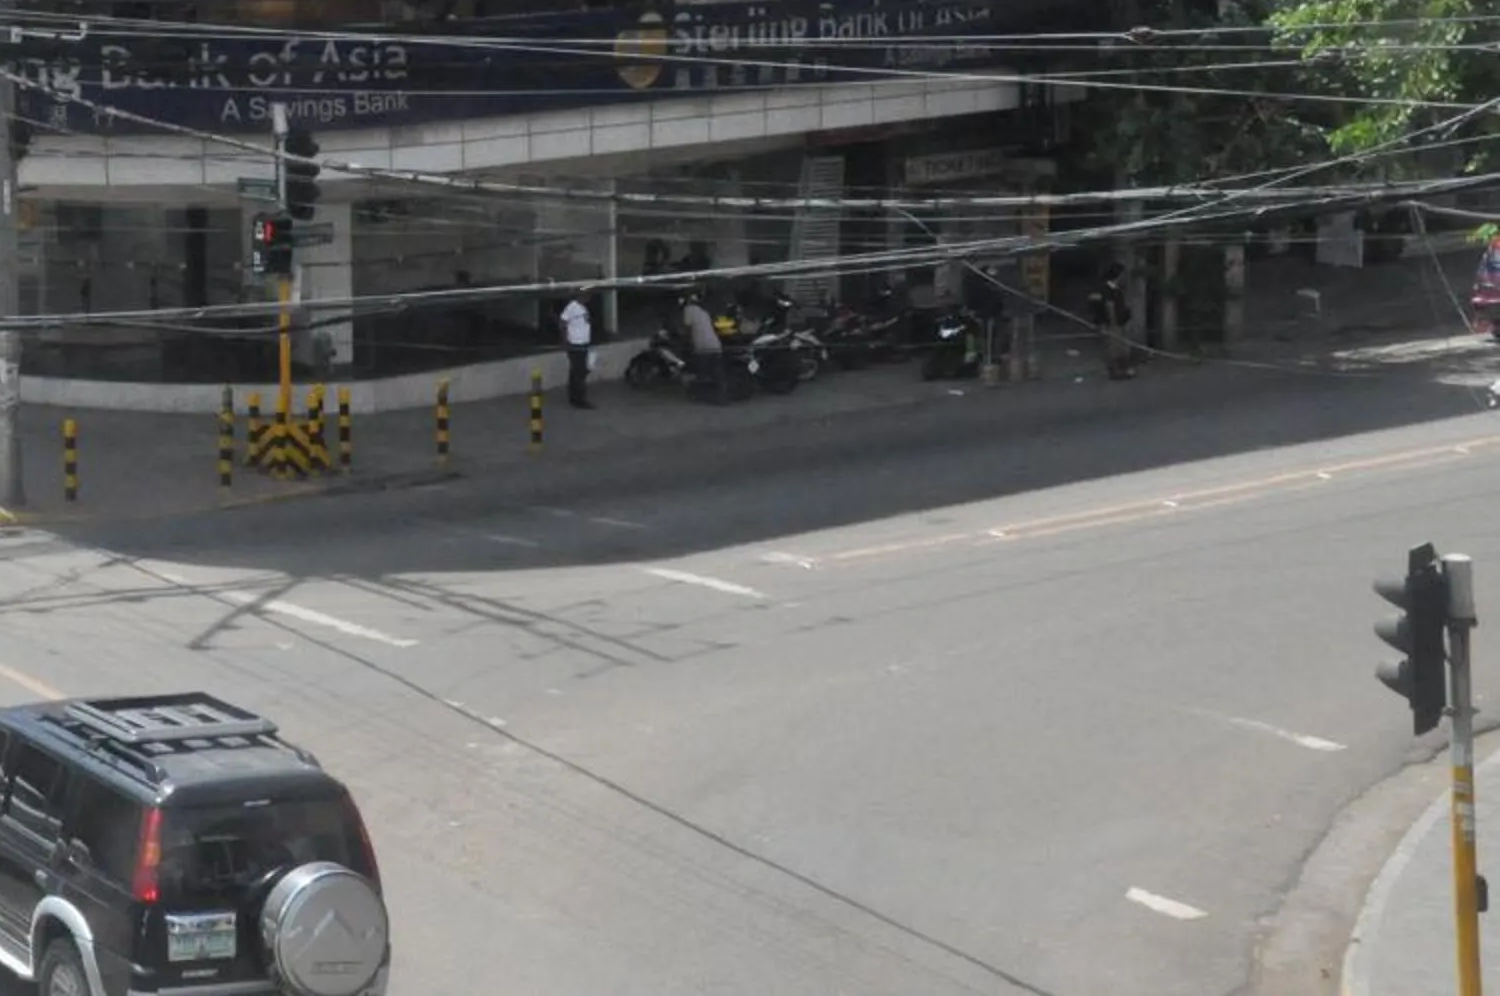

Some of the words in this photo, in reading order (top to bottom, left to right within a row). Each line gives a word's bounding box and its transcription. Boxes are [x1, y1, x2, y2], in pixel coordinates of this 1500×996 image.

[248, 38, 302, 86] of
[312, 40, 410, 84] Asia
[221, 98, 242, 122] A
[249, 96, 347, 123] Svings
[354, 92, 408, 115] Bank
